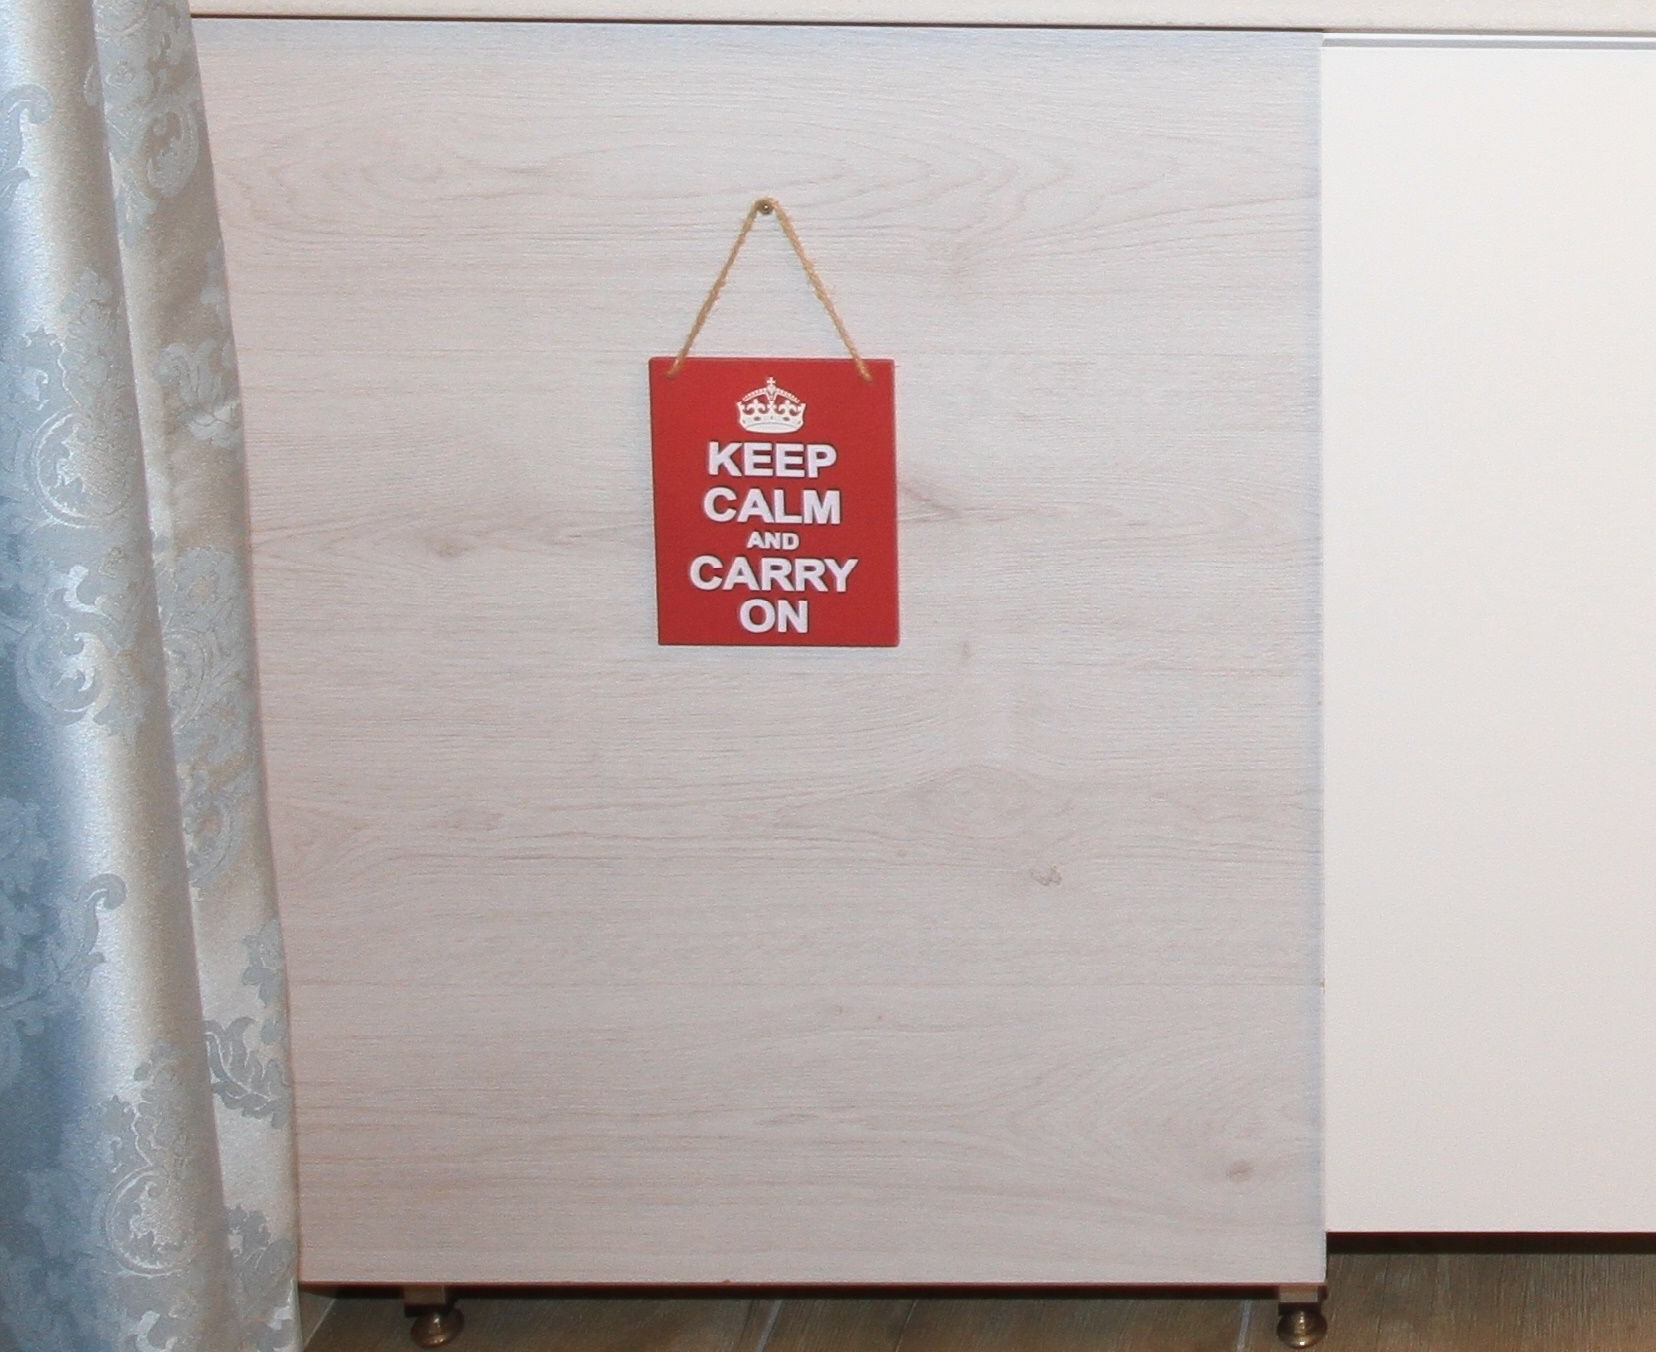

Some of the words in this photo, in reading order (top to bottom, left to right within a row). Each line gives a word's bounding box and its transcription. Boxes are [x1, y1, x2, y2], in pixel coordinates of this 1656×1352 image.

[708, 441, 837, 478] KEEP
[704, 487, 841, 525] CALM
[746, 531, 799, 550] AND
[689, 555, 858, 592] CARRY
[739, 599, 808, 633] ON
